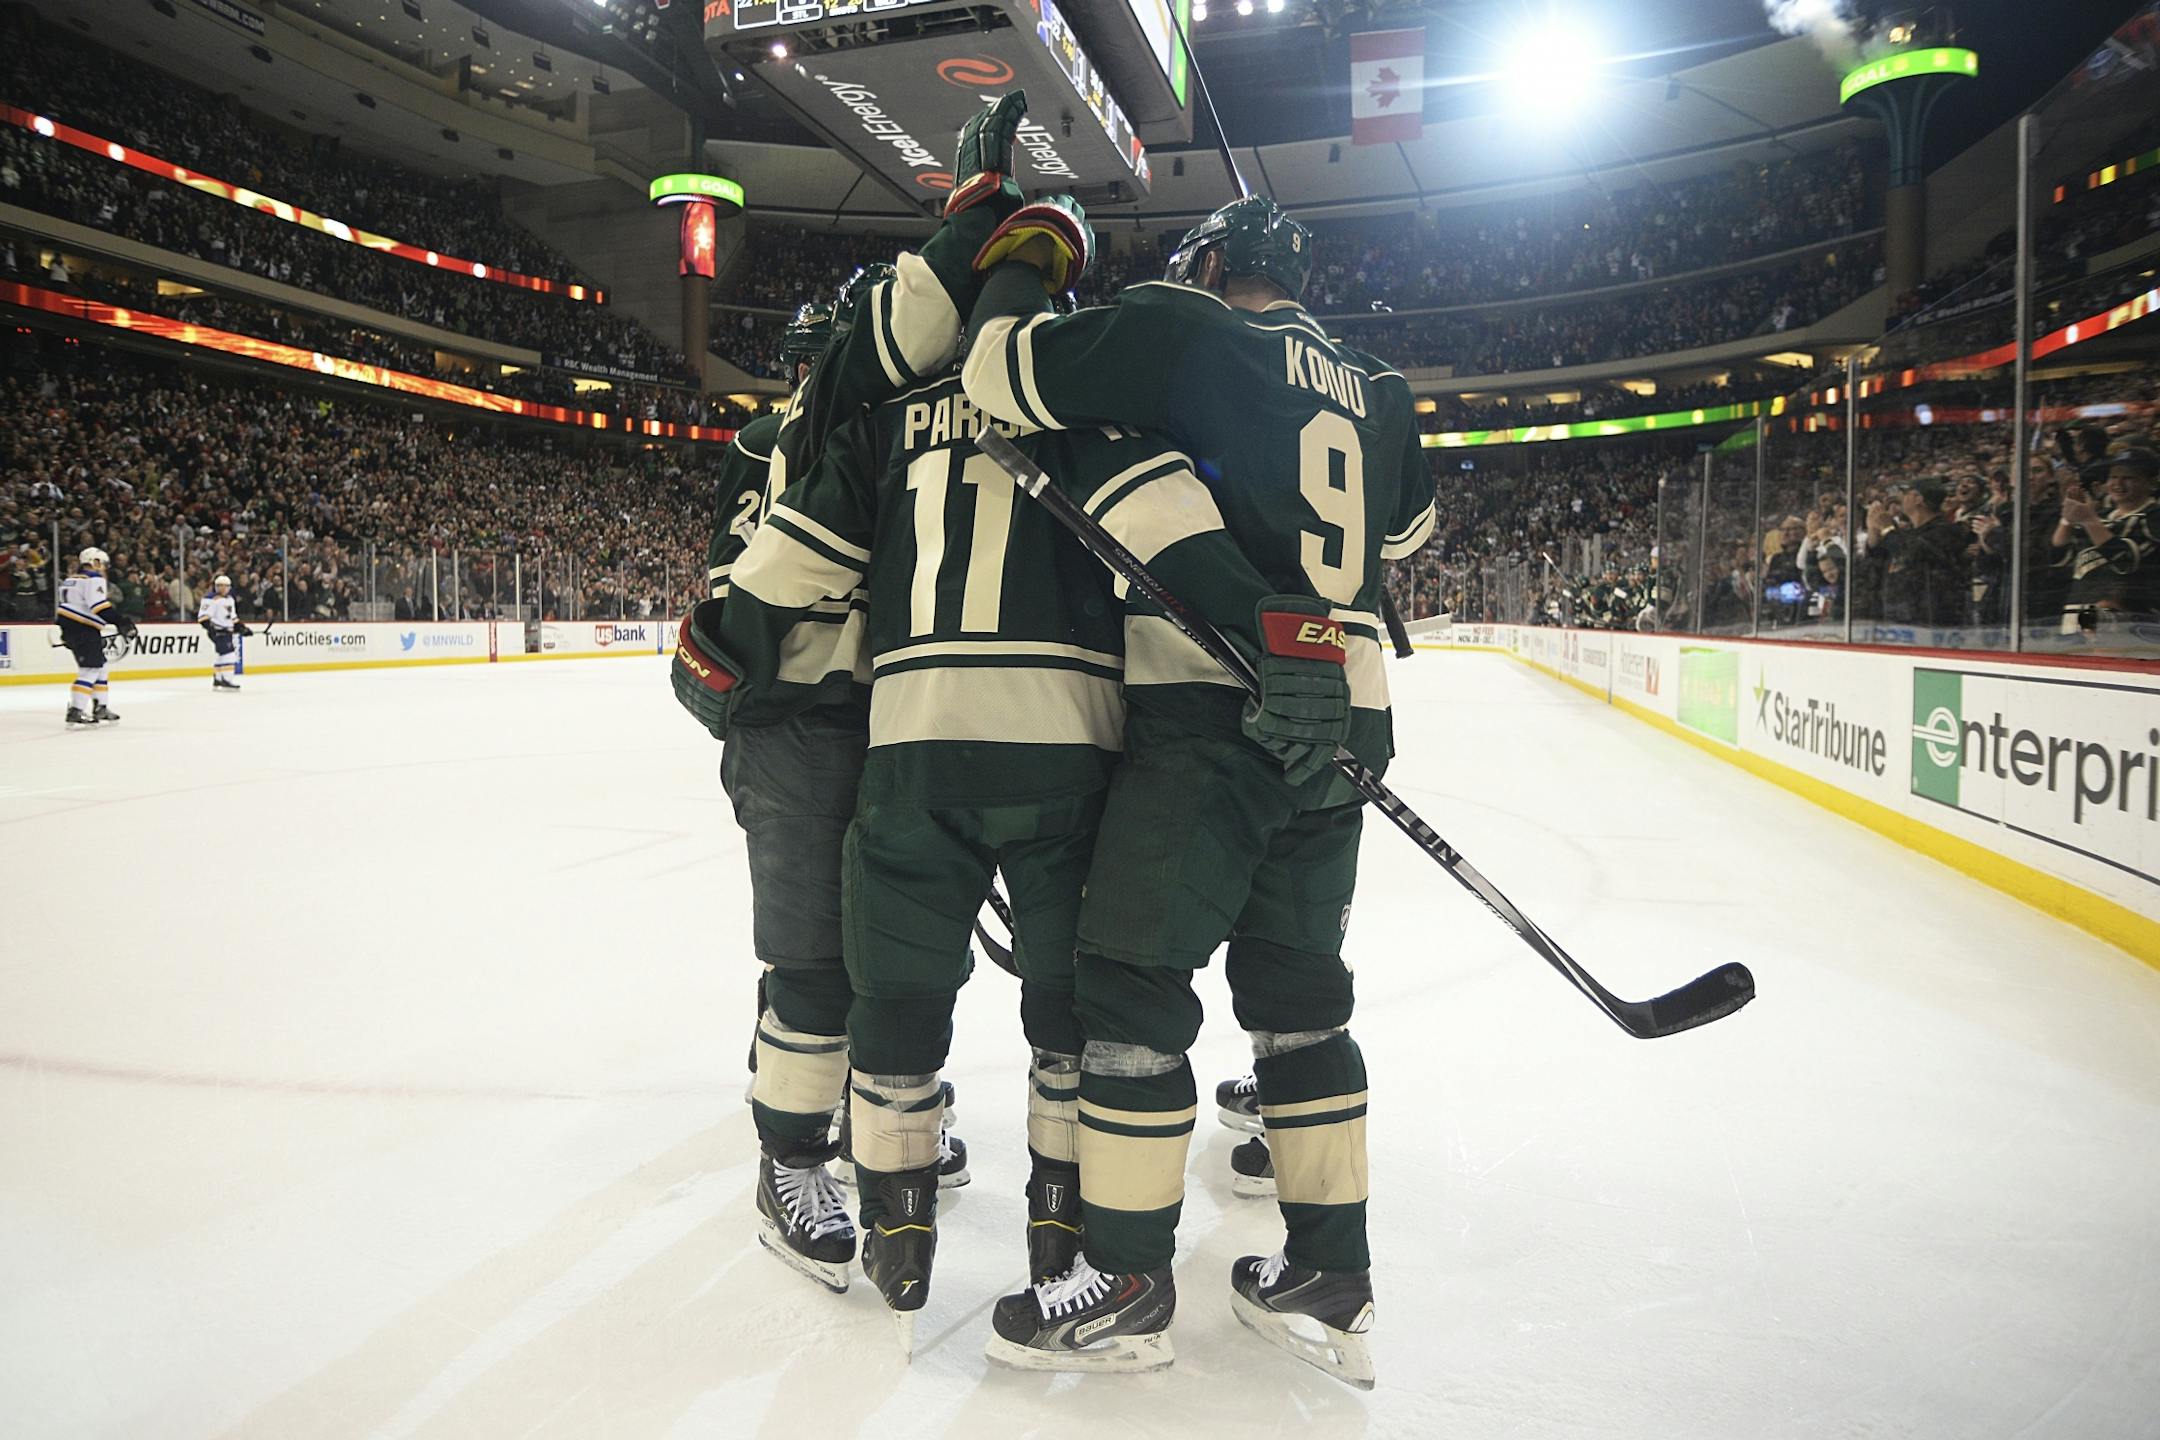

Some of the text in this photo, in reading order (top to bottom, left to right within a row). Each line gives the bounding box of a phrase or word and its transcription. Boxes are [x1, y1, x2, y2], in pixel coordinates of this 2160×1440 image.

[1292, 232, 1302, 254] 9
[564, 359, 580, 369] RBC
[581, 362, 609, 374] Wealth
[609, 367, 658, 382] Management
[1284, 335, 1367, 420] KOIVU
[906, 448, 1015, 639] 11
[1299, 409, 1365, 607] 9
[134, 635, 200, 656] NORTH
[1774, 690, 1887, 777] StarTribune
